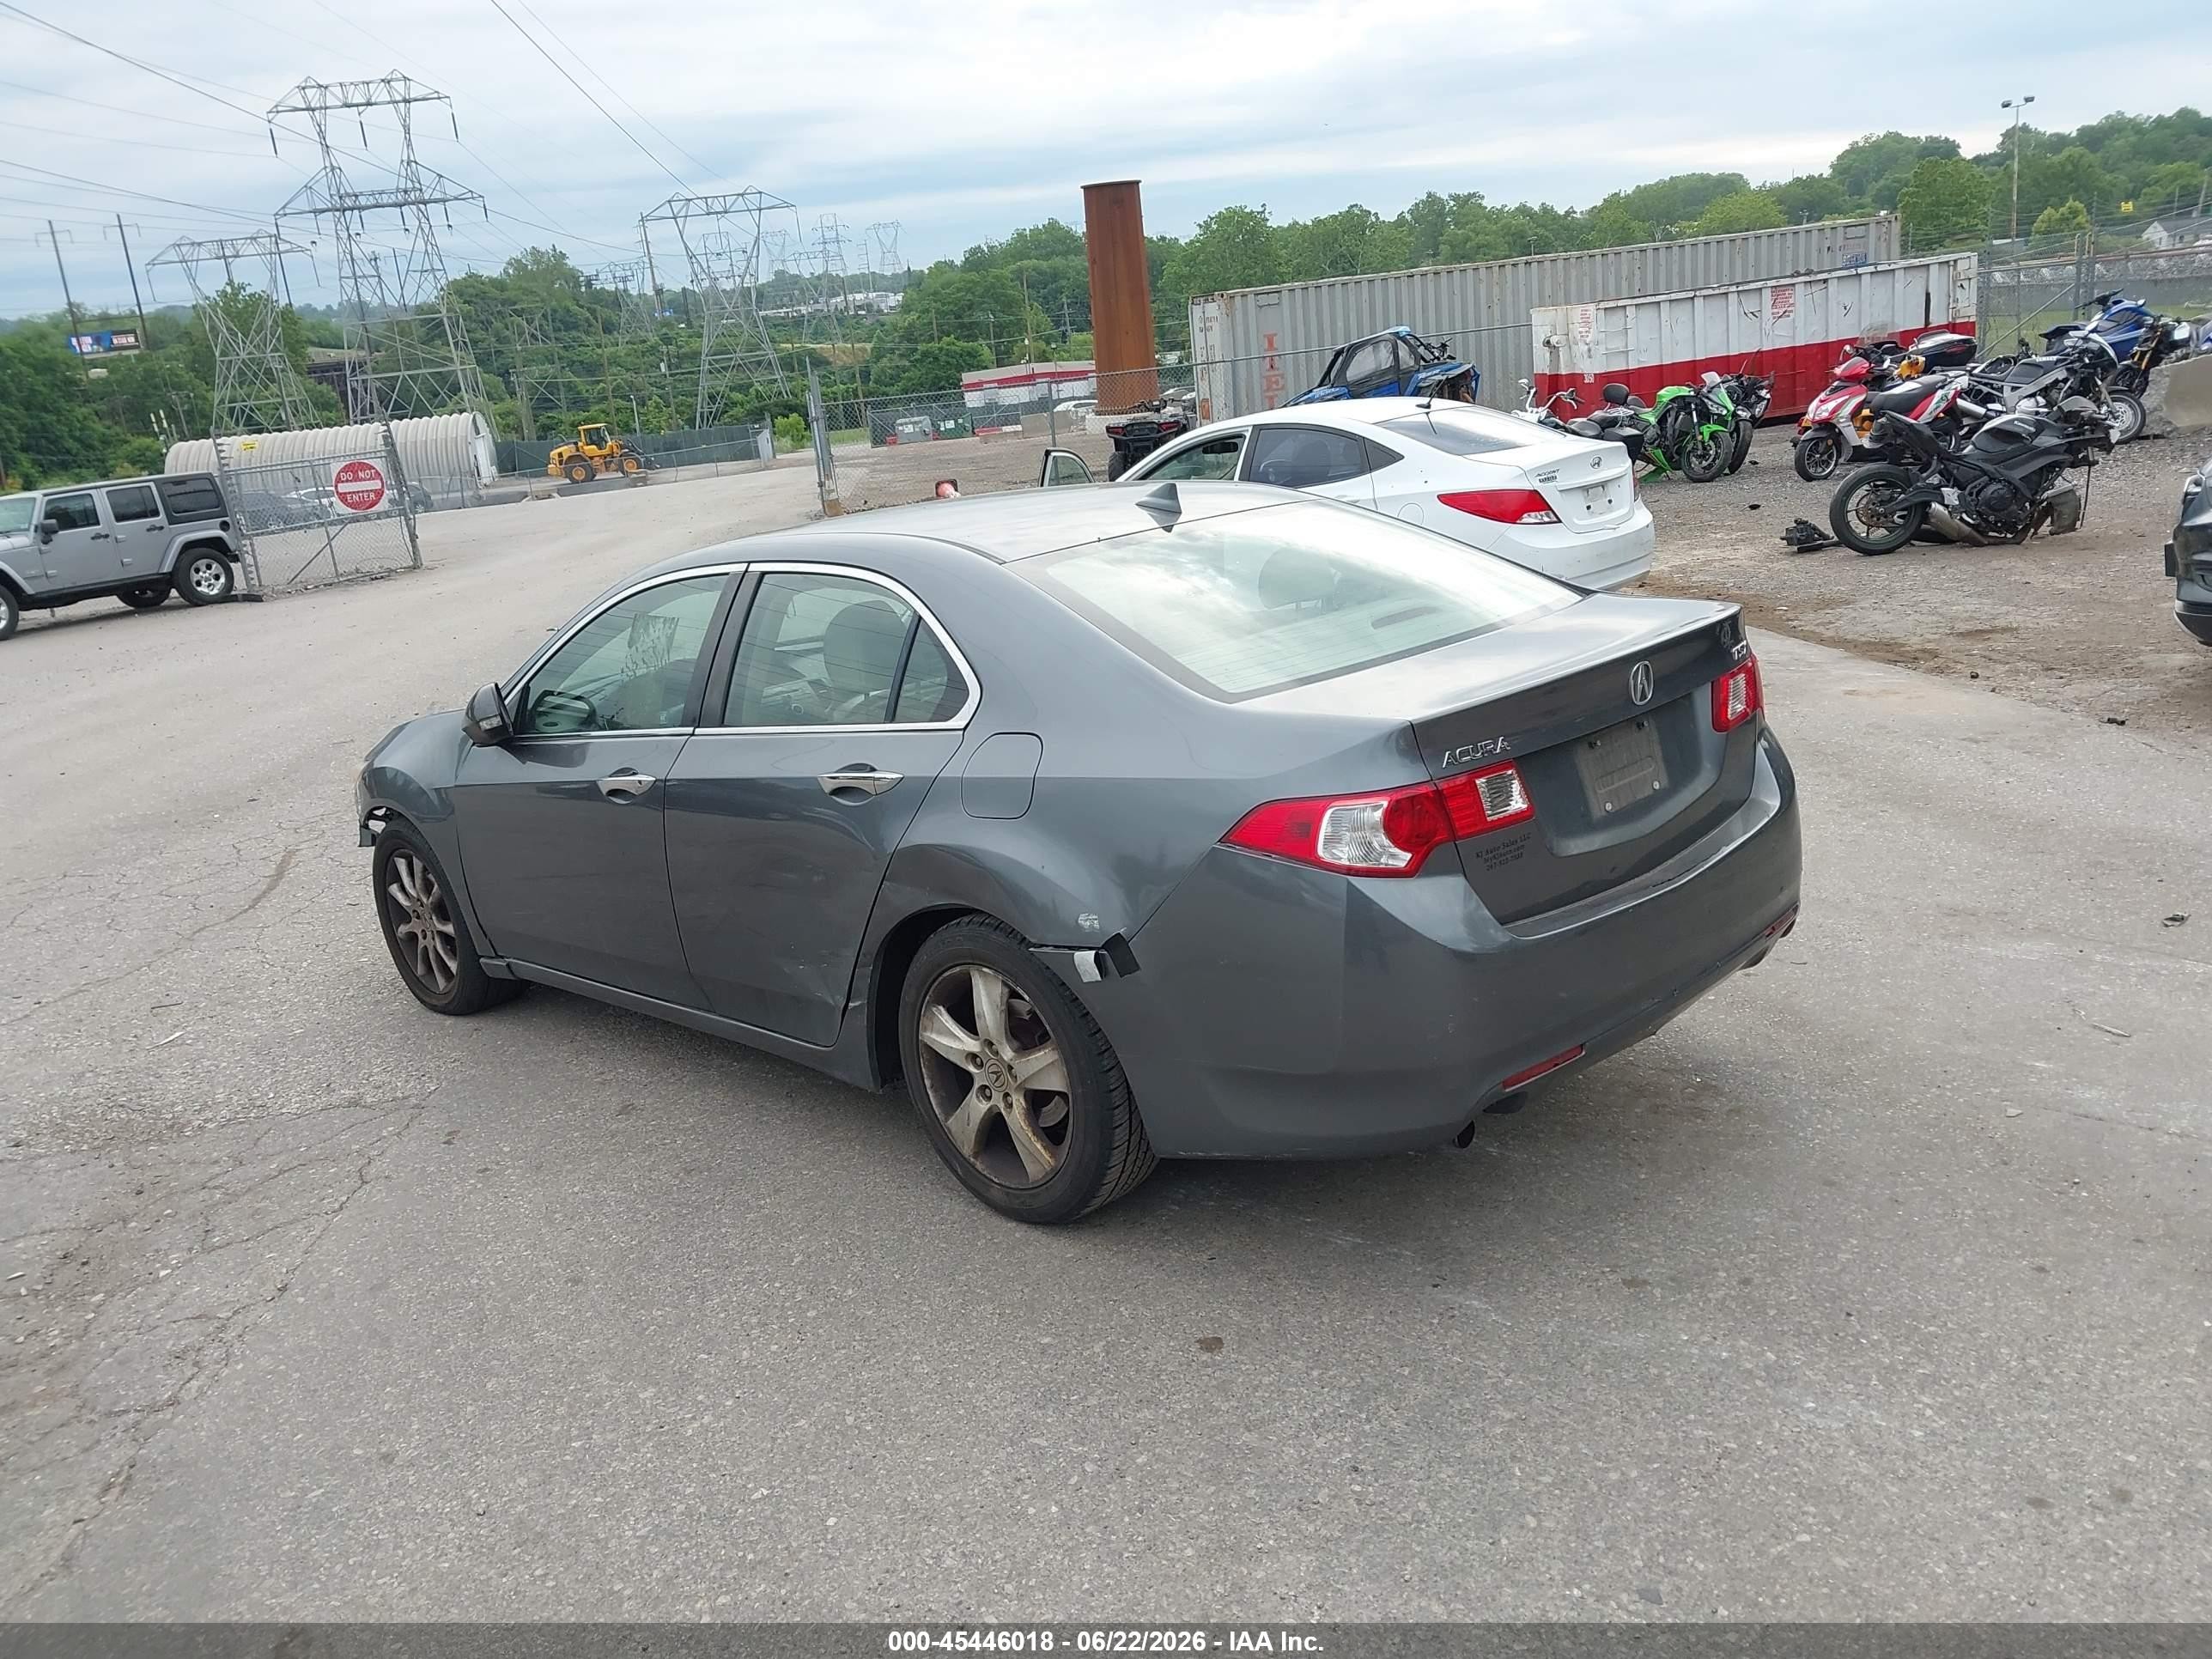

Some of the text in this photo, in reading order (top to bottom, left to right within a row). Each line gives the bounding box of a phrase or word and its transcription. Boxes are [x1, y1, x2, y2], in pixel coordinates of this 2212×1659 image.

[340, 469, 376, 481] DO NOT
[346, 491, 375, 503] ENTER
[1442, 736, 1511, 769] ACURA
